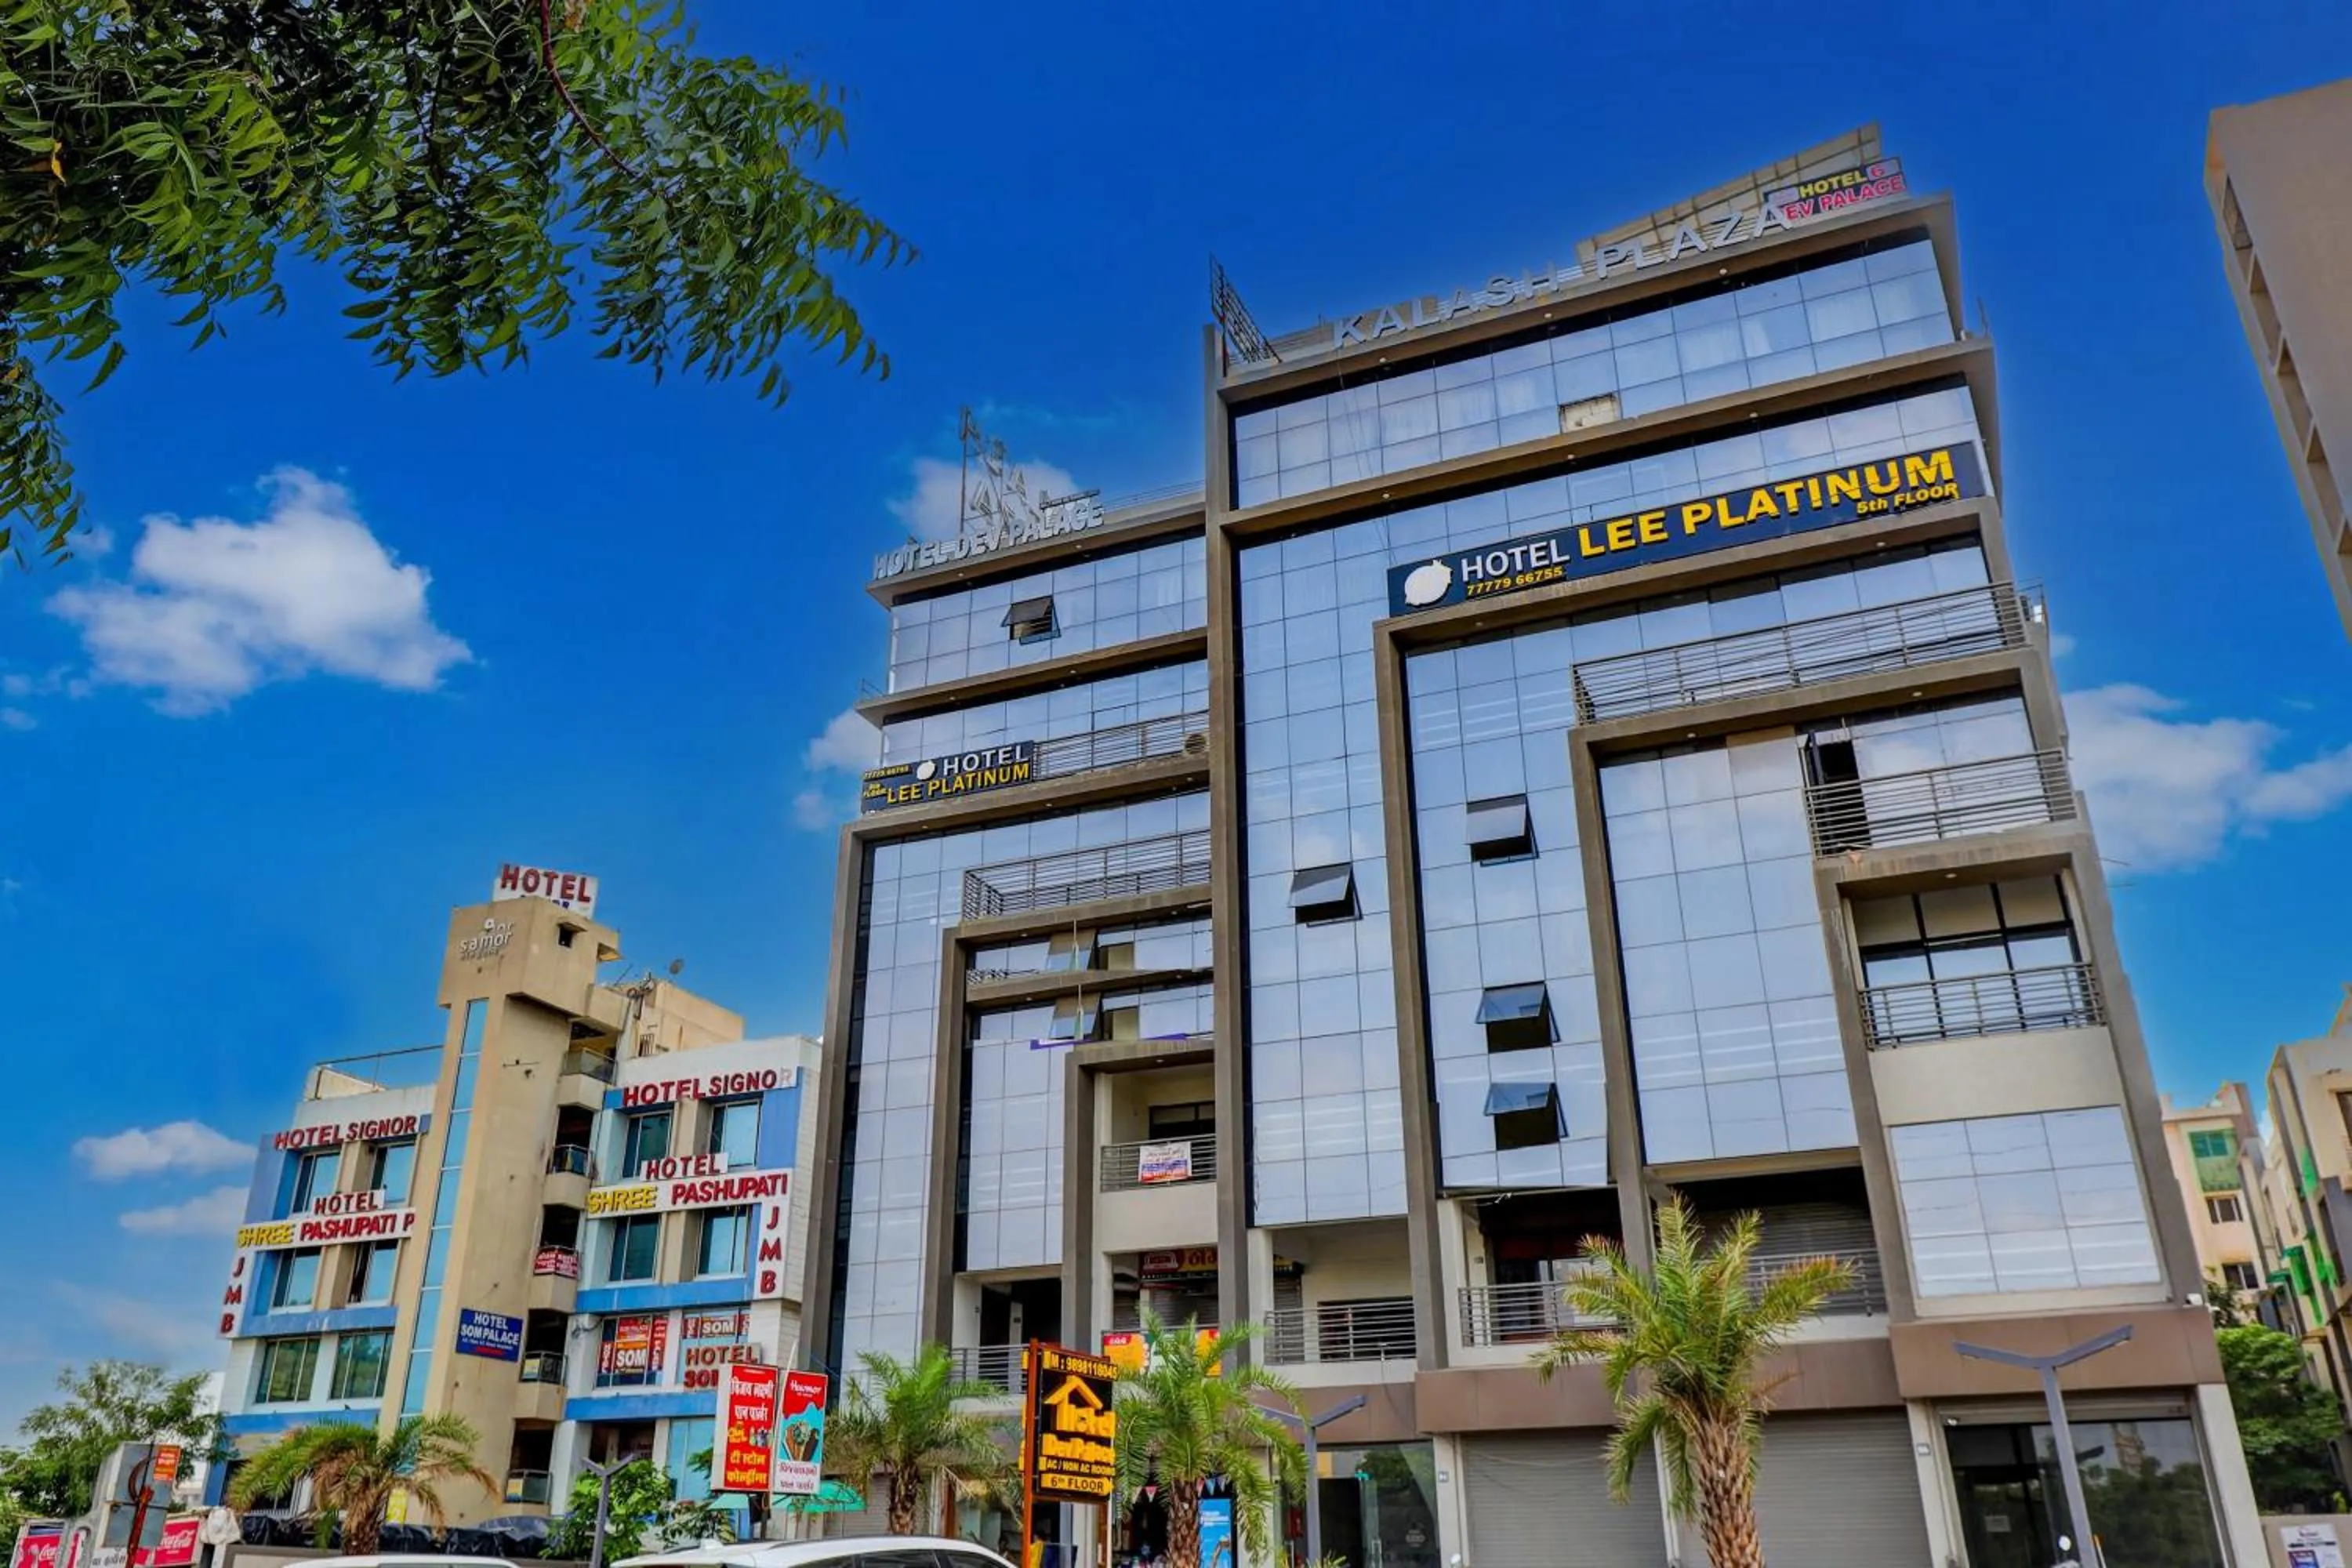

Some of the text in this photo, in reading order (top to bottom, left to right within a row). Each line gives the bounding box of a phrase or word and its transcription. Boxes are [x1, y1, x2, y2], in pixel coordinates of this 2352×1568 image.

[1781, 175, 1907, 221] EV PALACE
[1799, 171, 1867, 198] HOTEL
[1334, 196, 1793, 350] KALASH PLAZA
[1856, 482, 1961, 515] 5th FLOOR
[1460, 450, 1955, 583] HOTEL LEE PLATINUM
[873, 499, 1105, 580] HOTEL DEV PALACE
[1467, 565, 1565, 596] 77779 66755
[943, 745, 1029, 776] HOTEL
[887, 783, 923, 804] LEE
[927, 763, 1029, 797] PLATINUM
[500, 864, 591, 903] HOTEL
[622, 1077, 706, 1107] HOTEL
[274, 1116, 417, 1151] HOTEL SIGNOR
[646, 1153, 720, 1179] HOTEL
[314, 1192, 378, 1215] HOTEL
[588, 1173, 788, 1214] SHREE PASHUPATI
[238, 1223, 295, 1248] SHREE
[299, 1213, 397, 1242] PASHUPATI
[473, 1312, 509, 1330] HOTEL
[702, 1320, 734, 1334] SOM
[615, 1348, 647, 1368] SOM
[684, 1346, 759, 1367] HOTEL
[1067, 1477, 1104, 1494] FLOOR
